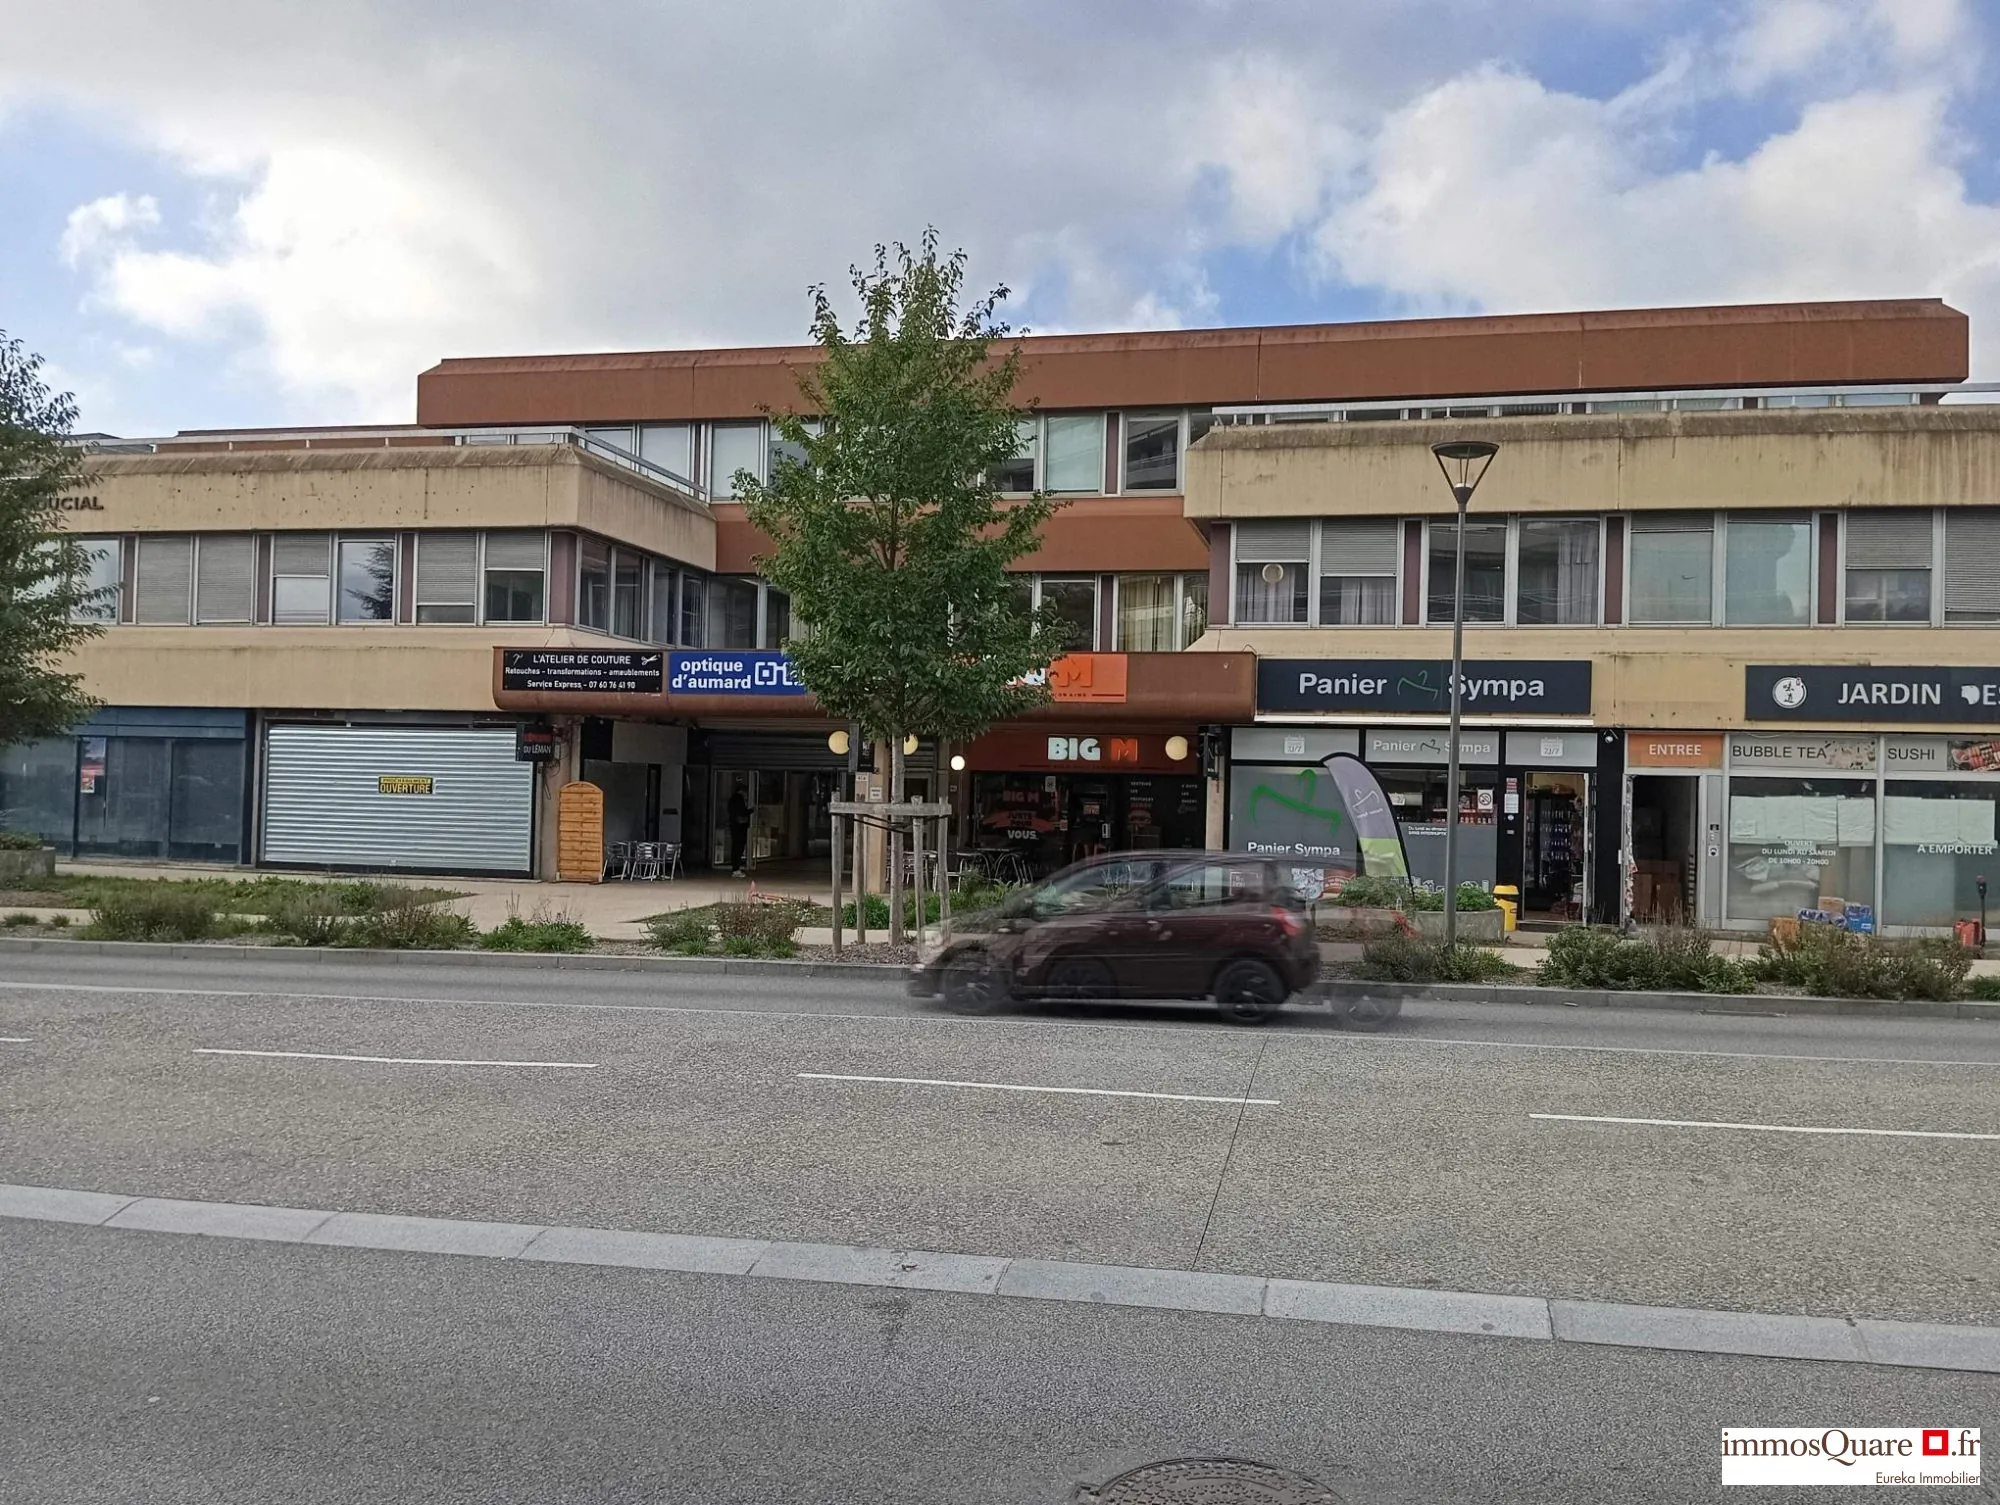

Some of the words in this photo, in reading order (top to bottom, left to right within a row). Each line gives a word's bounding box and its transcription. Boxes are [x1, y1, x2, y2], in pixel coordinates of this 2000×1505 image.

[532, 655, 575, 664] L'ATELIER
[577, 655, 588, 664] DE
[591, 655, 631, 665] COUTURE
[680, 657, 743, 675] optique
[505, 667, 540, 675] Retouches
[547, 668, 602, 676] transformations
[609, 668, 660, 677] ameublements
[527, 680, 552, 688] Service
[554, 681, 582, 690] Express
[672, 674, 751, 689] d'aumard
[1299, 673, 1387, 695] Panier
[1838, 683, 1941, 705] JARDIN
[1961, 684, 2000, 706] DE
[1048, 737, 1101, 761] BIG
[1110, 738, 1138, 761] M
[1373, 740, 1417, 752] Panier
[1444, 741, 1491, 754] Smpa
[1649, 744, 1702, 756] ENTREE
[1732, 745, 1792, 758] BUBBLE
[1797, 746, 1827, 759] TEA
[1887, 748, 1935, 760] SUSHI
[380, 783, 431, 793] OUVERTURE
[1247, 842, 1290, 854] Panier
[1294, 843, 1341, 857] Sympa
[1917, 844, 1926, 854] A
[1929, 844, 1993, 855] EMPORTER
